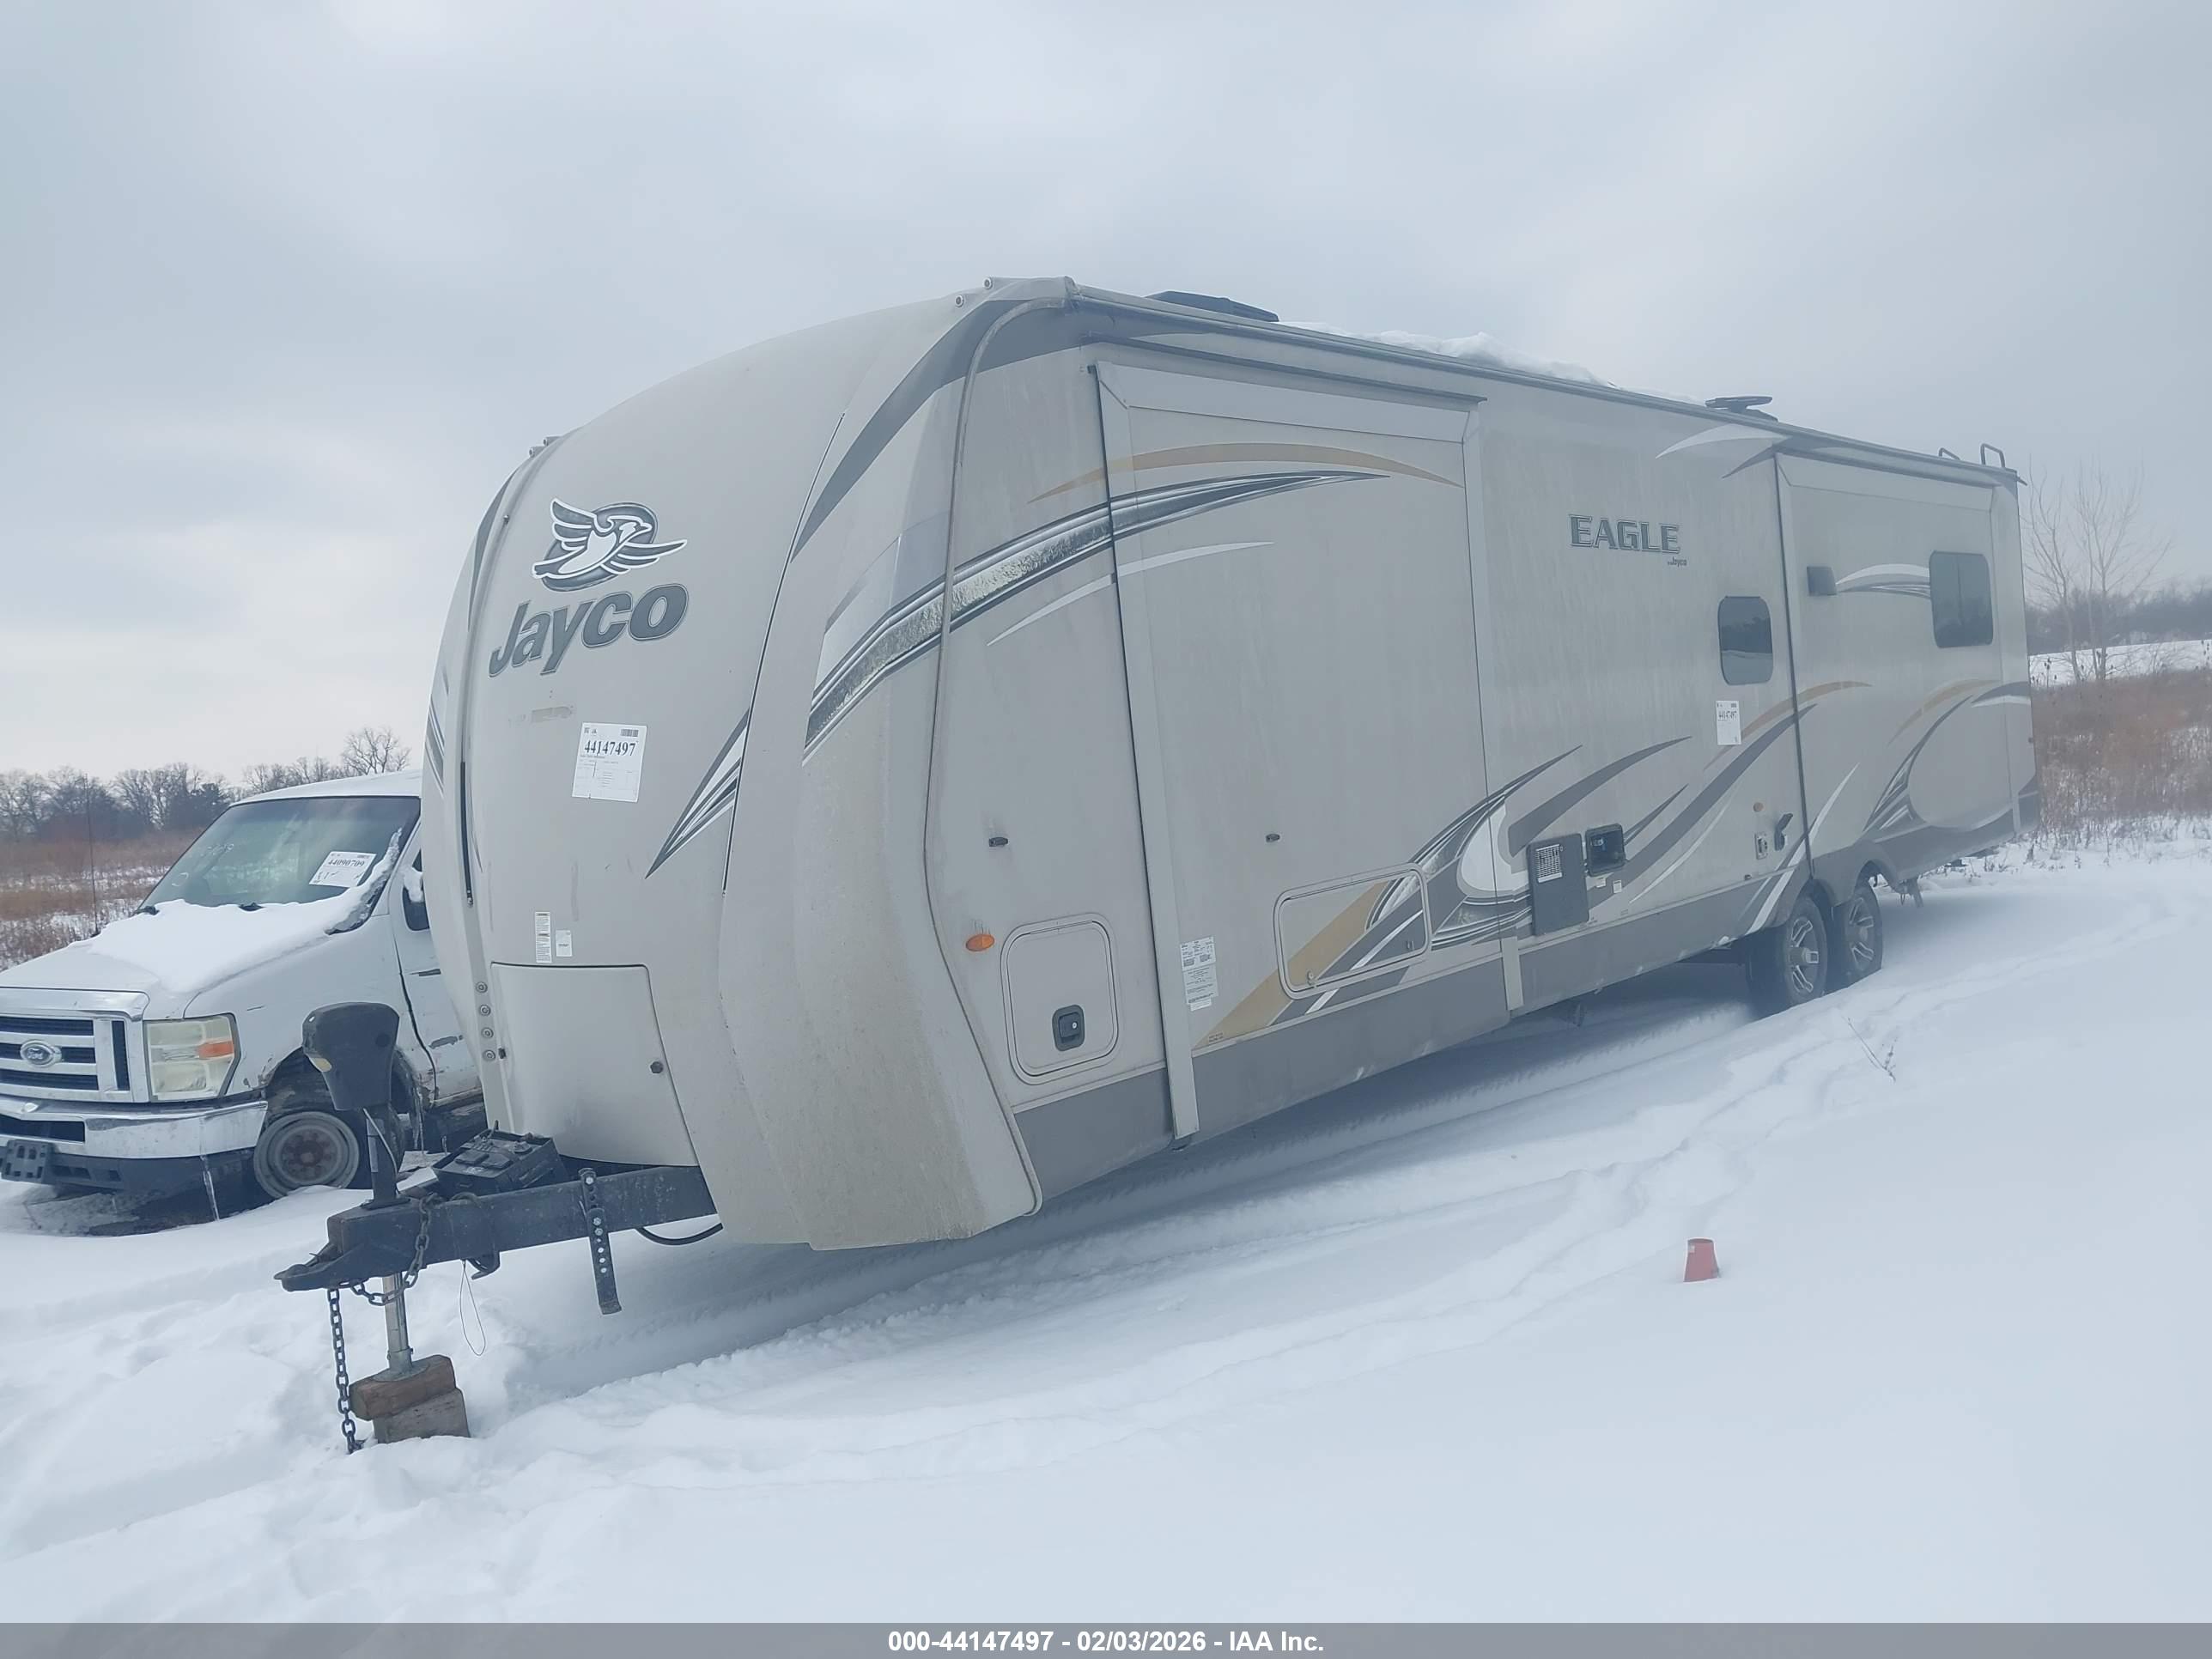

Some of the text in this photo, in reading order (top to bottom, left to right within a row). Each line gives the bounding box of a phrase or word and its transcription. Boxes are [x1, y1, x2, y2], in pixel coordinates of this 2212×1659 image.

[1569, 514, 1680, 554] EAGLE
[488, 583, 689, 678] Jayco
[584, 739, 636, 757] 44147497
